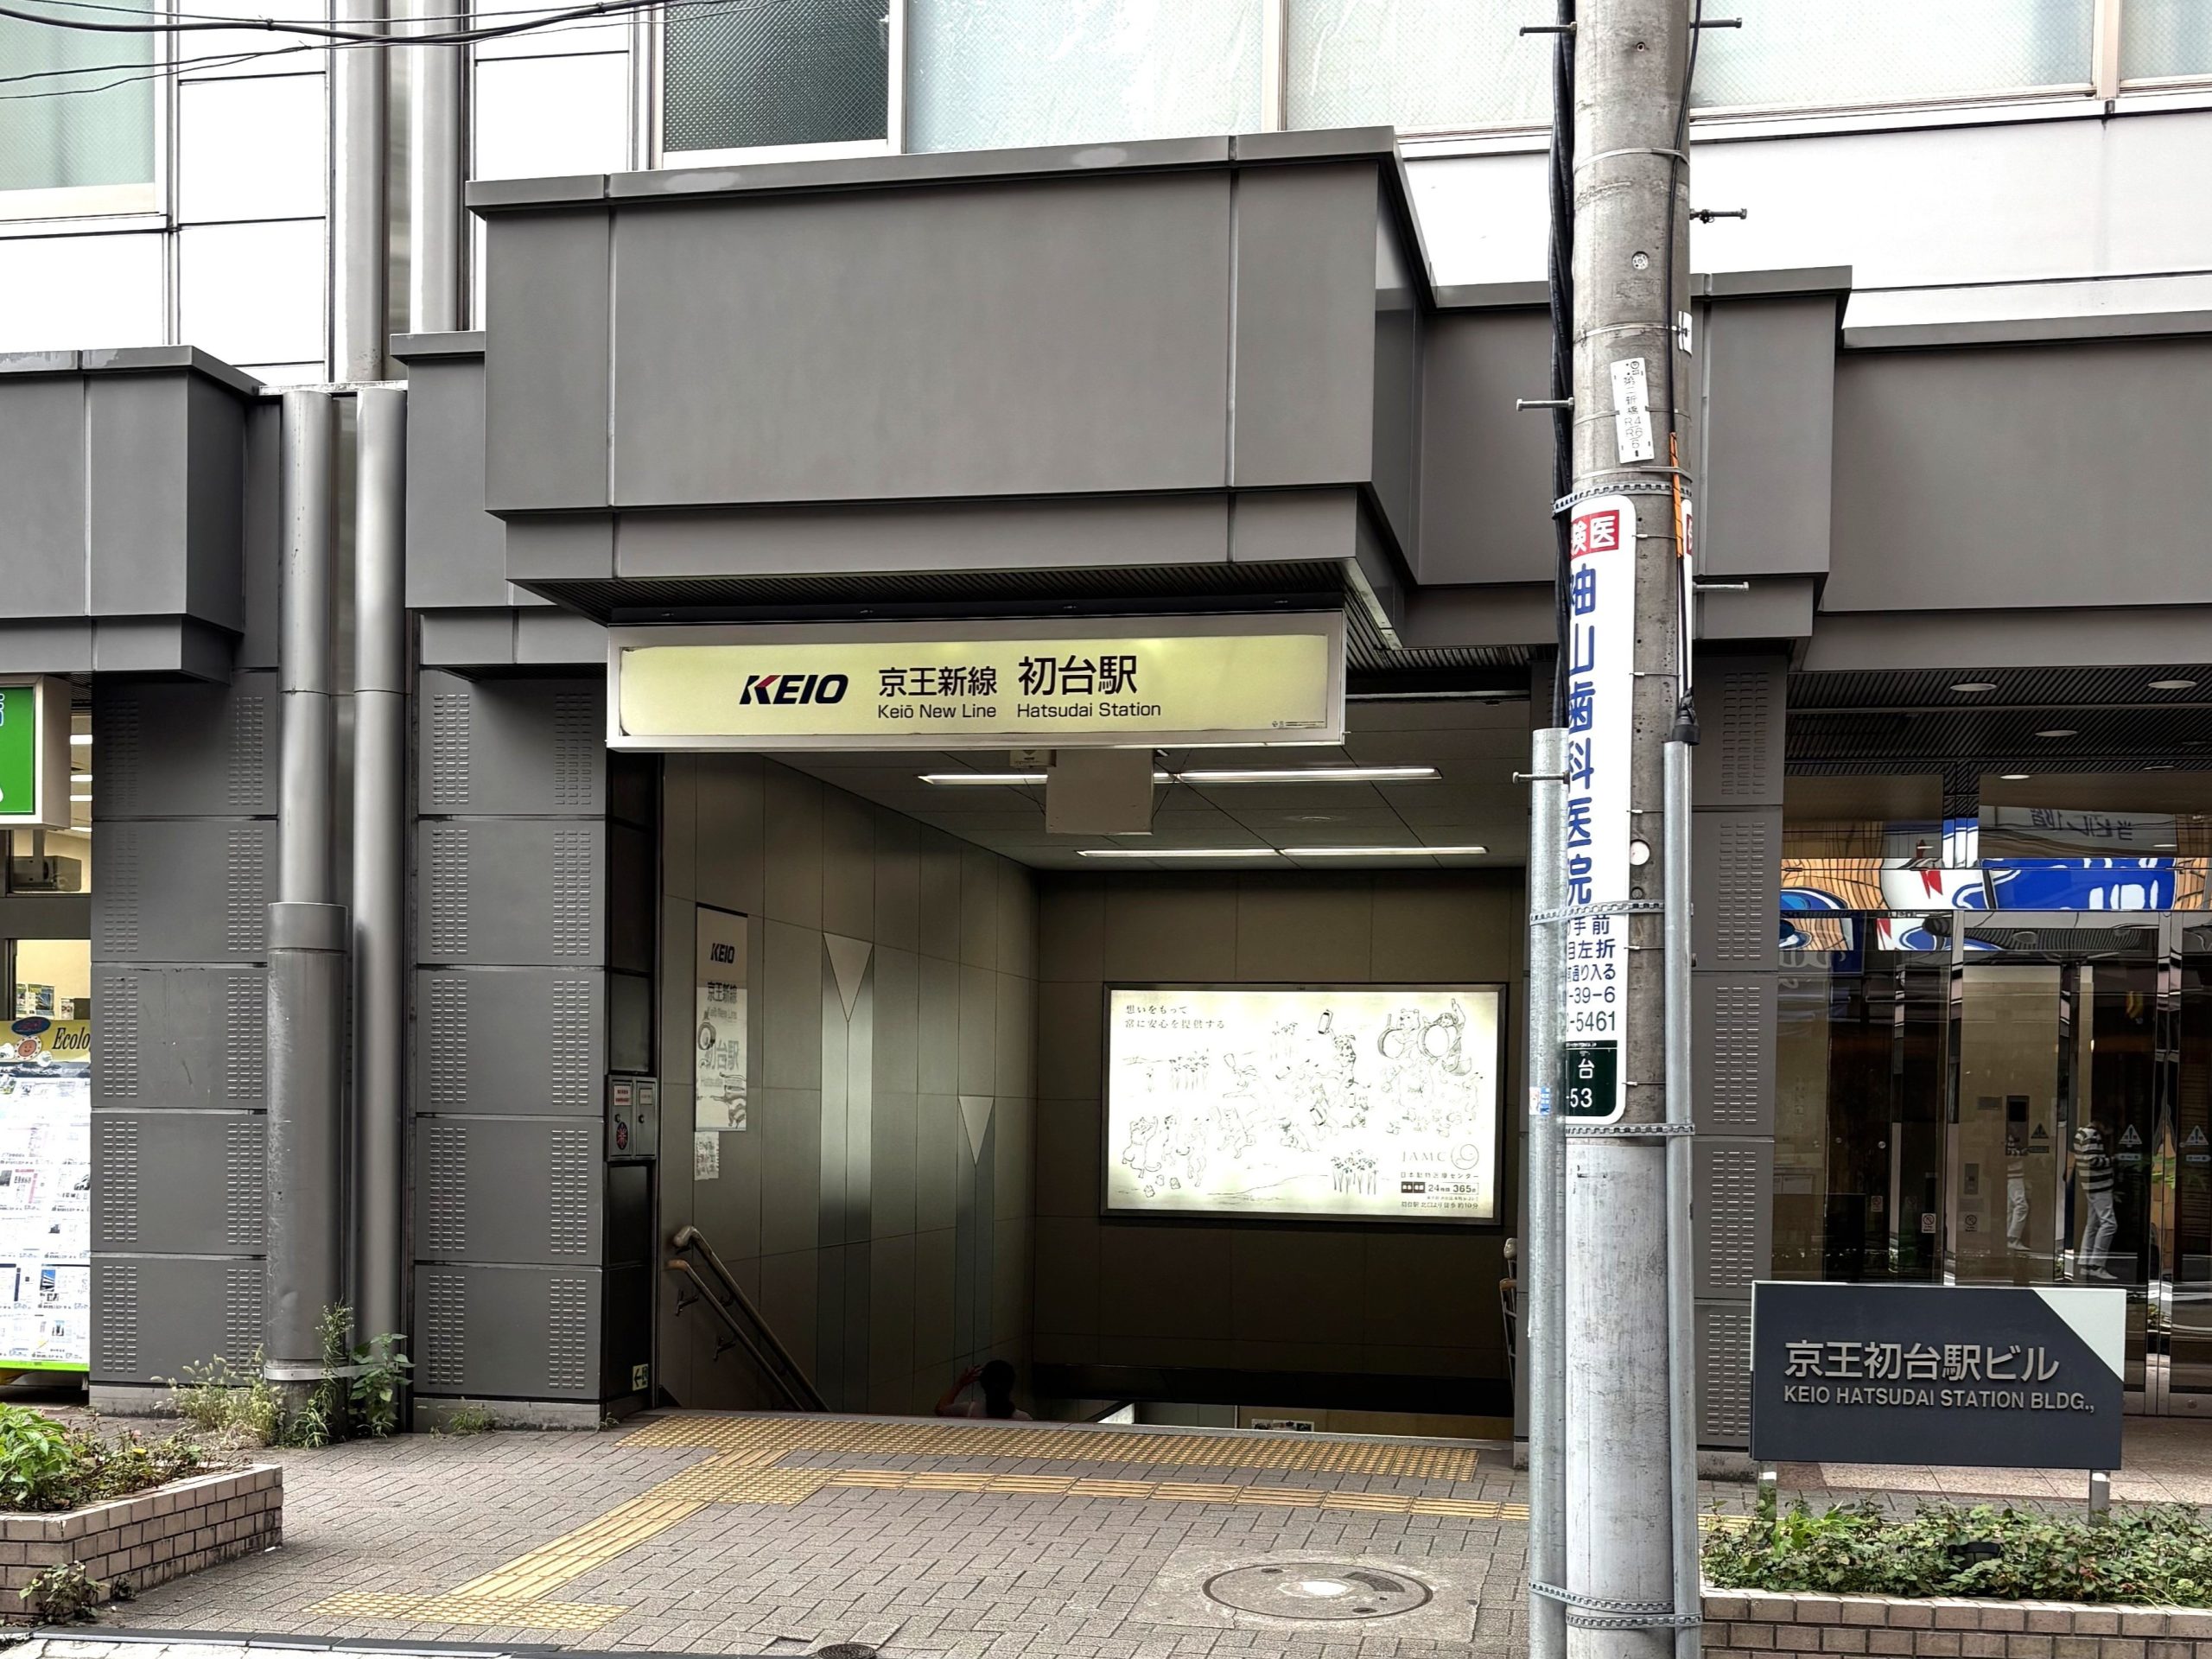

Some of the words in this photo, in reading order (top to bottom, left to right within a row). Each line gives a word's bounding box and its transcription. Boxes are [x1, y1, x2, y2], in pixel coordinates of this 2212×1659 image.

[878, 666, 998, 697] 京王新線
[1018, 654, 1138, 696] 初台駅
[739, 674, 849, 704] KEIO
[878, 704, 914, 719] Keiō
[919, 704, 957, 718] New
[962, 703, 997, 718] Line
[1017, 702, 1093, 718] Hatsudai
[1099, 702, 1161, 717] Station
[710, 943, 735, 964] KEIO
[1568, 986, 1616, 1003] -39-6
[1567, 1010, 1616, 1032] -5461
[1784, 1340, 2060, 1382] 京王初台駅ビル
[1783, 1385, 1831, 1404] KEIO
[1836, 1387, 1935, 1406] HATSUDAI
[1941, 1389, 2024, 1408] STATION
